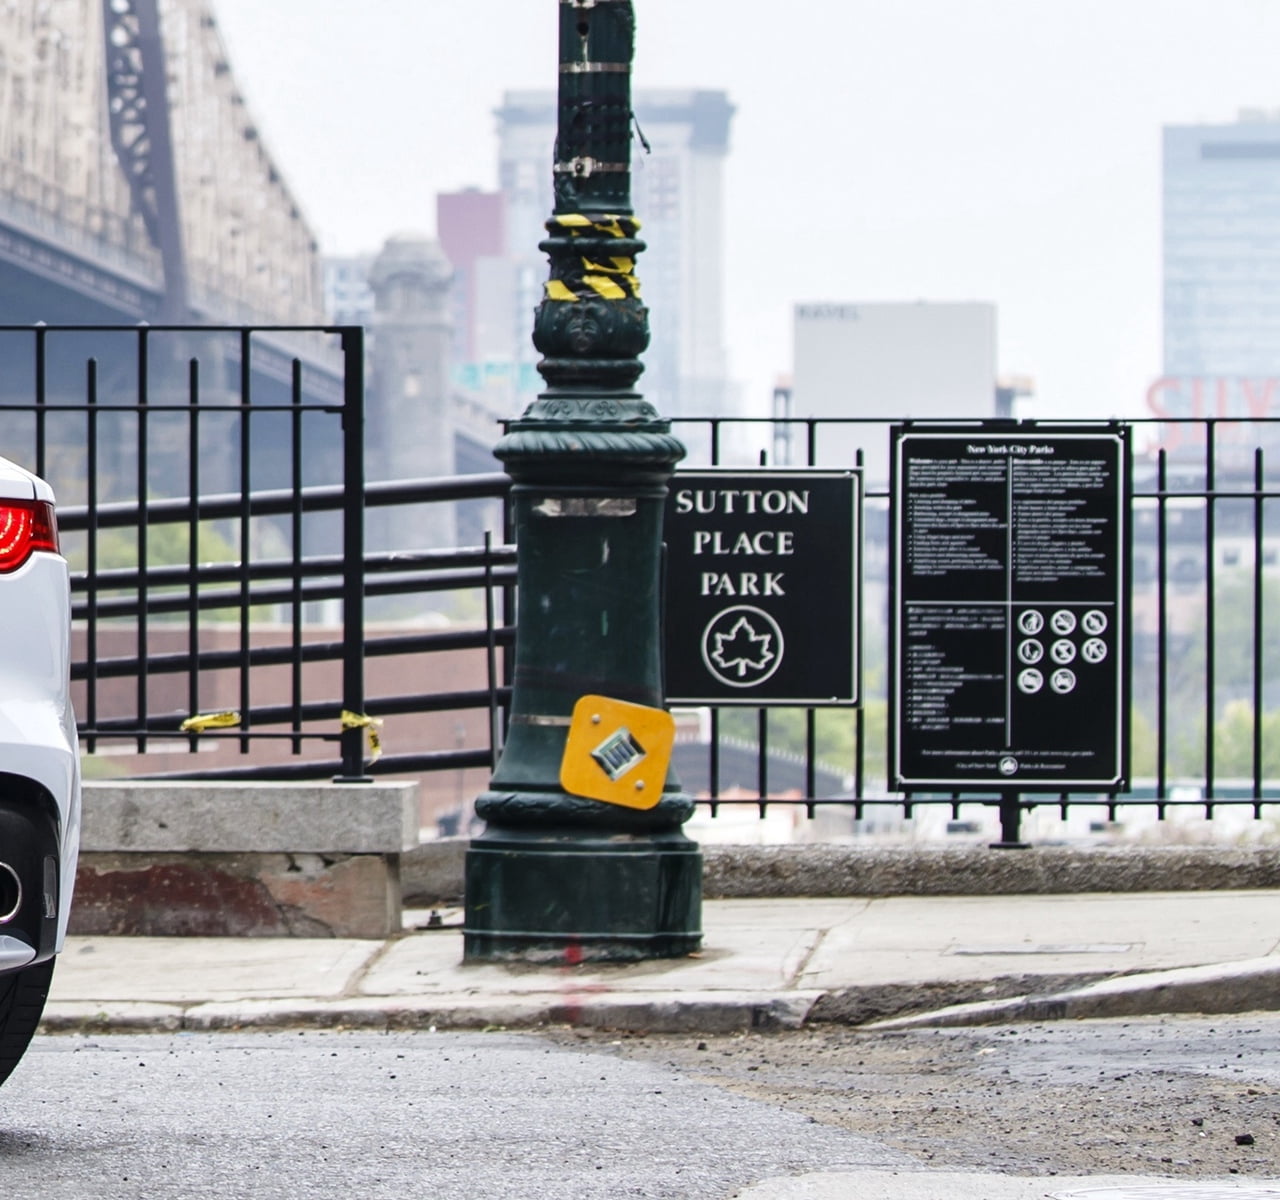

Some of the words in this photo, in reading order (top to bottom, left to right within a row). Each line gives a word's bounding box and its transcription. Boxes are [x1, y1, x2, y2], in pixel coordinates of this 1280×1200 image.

[966, 444, 986, 454] New
[987, 444, 1008, 454] York
[1009, 444, 1028, 456] City
[1029, 444, 1055, 455] Parks
[675, 489, 810, 514] SUTTON
[692, 531, 795, 555] PLACE
[700, 572, 786, 596] PARK
